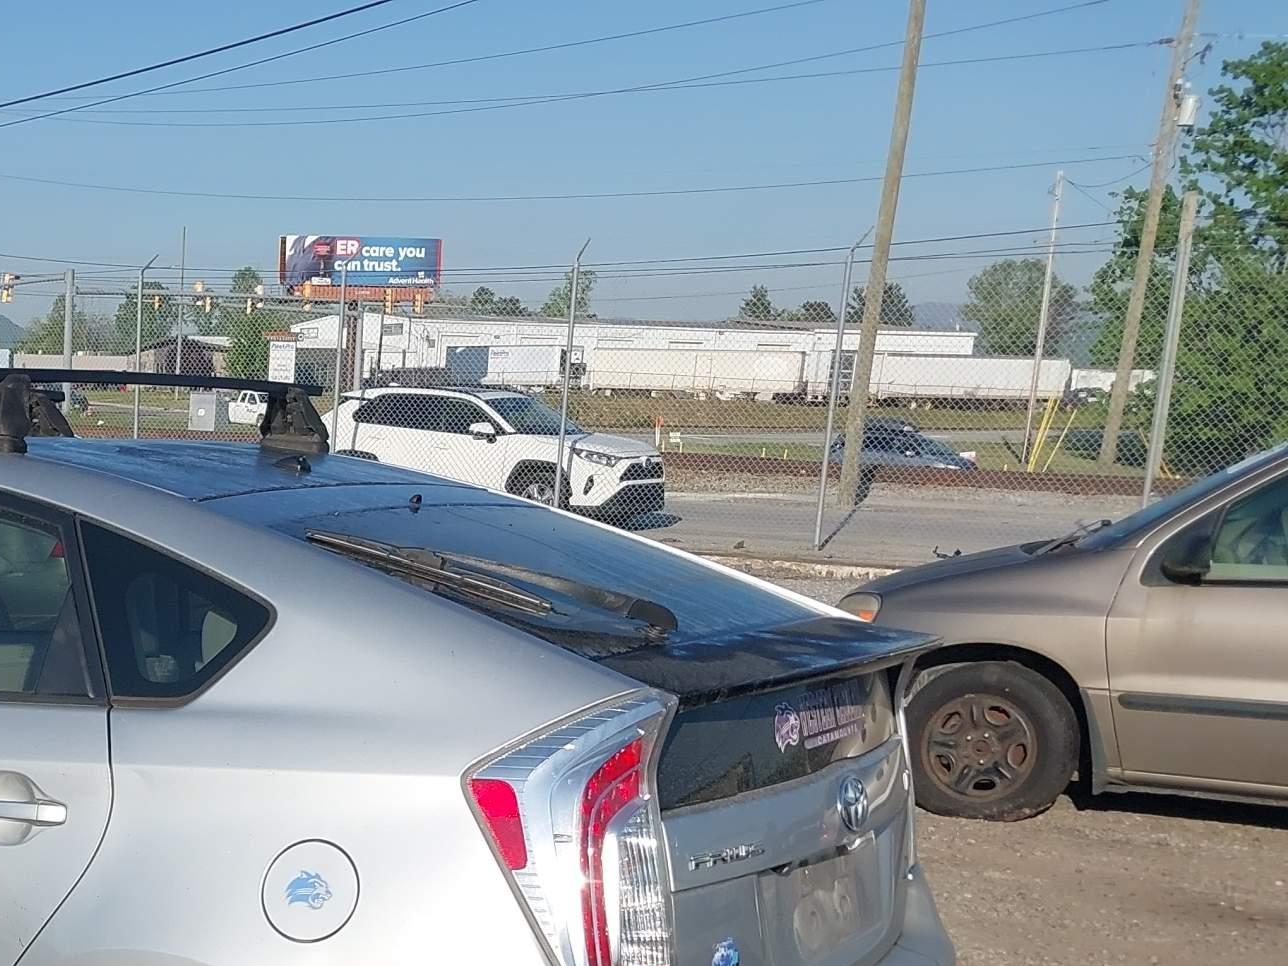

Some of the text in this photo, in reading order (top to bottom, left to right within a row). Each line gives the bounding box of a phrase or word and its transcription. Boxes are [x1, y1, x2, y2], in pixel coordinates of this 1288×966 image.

[336, 240, 425, 260] ER care you
[363, 259, 401, 272] trust.
